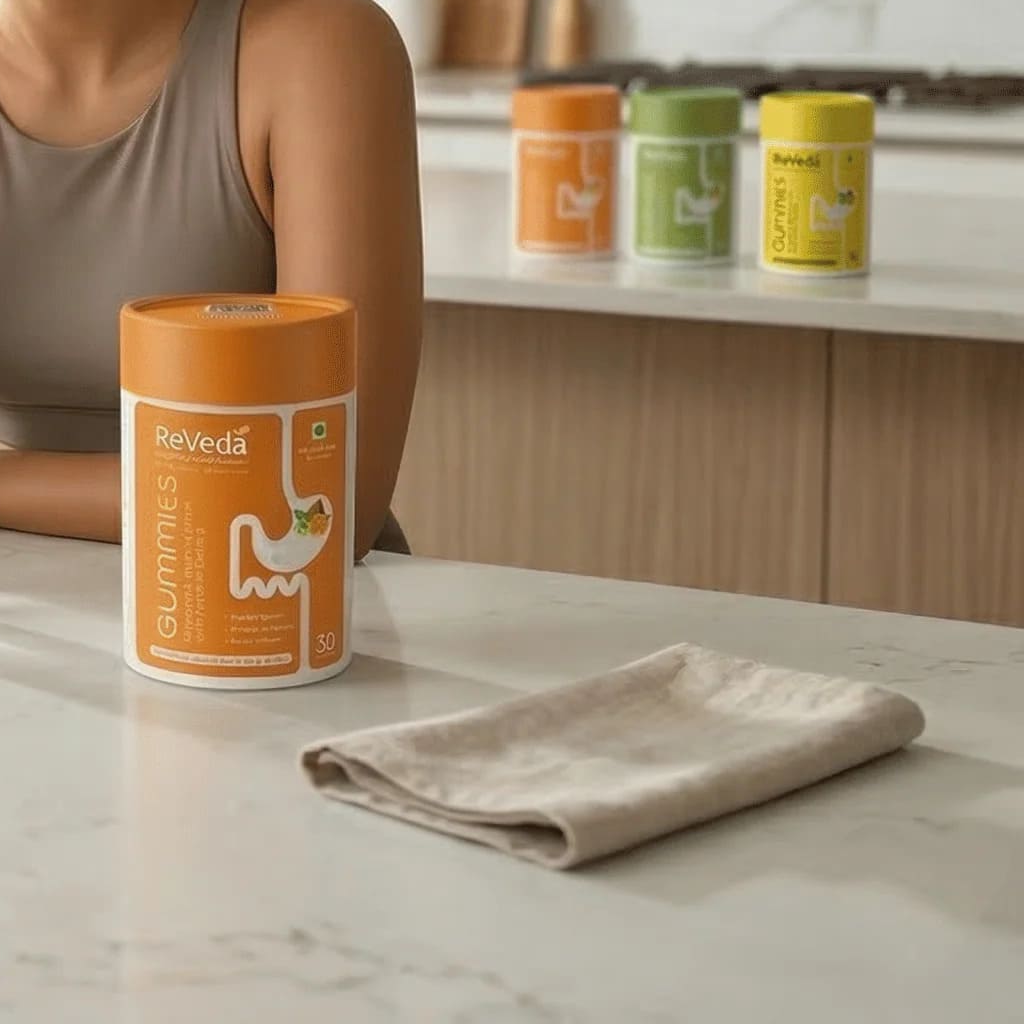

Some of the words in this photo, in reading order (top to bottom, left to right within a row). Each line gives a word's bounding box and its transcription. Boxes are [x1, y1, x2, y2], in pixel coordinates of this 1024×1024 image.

[155, 425, 248, 455] ReVeda
[156, 474, 178, 640] GUMMIES
[315, 631, 336, 654] 30
